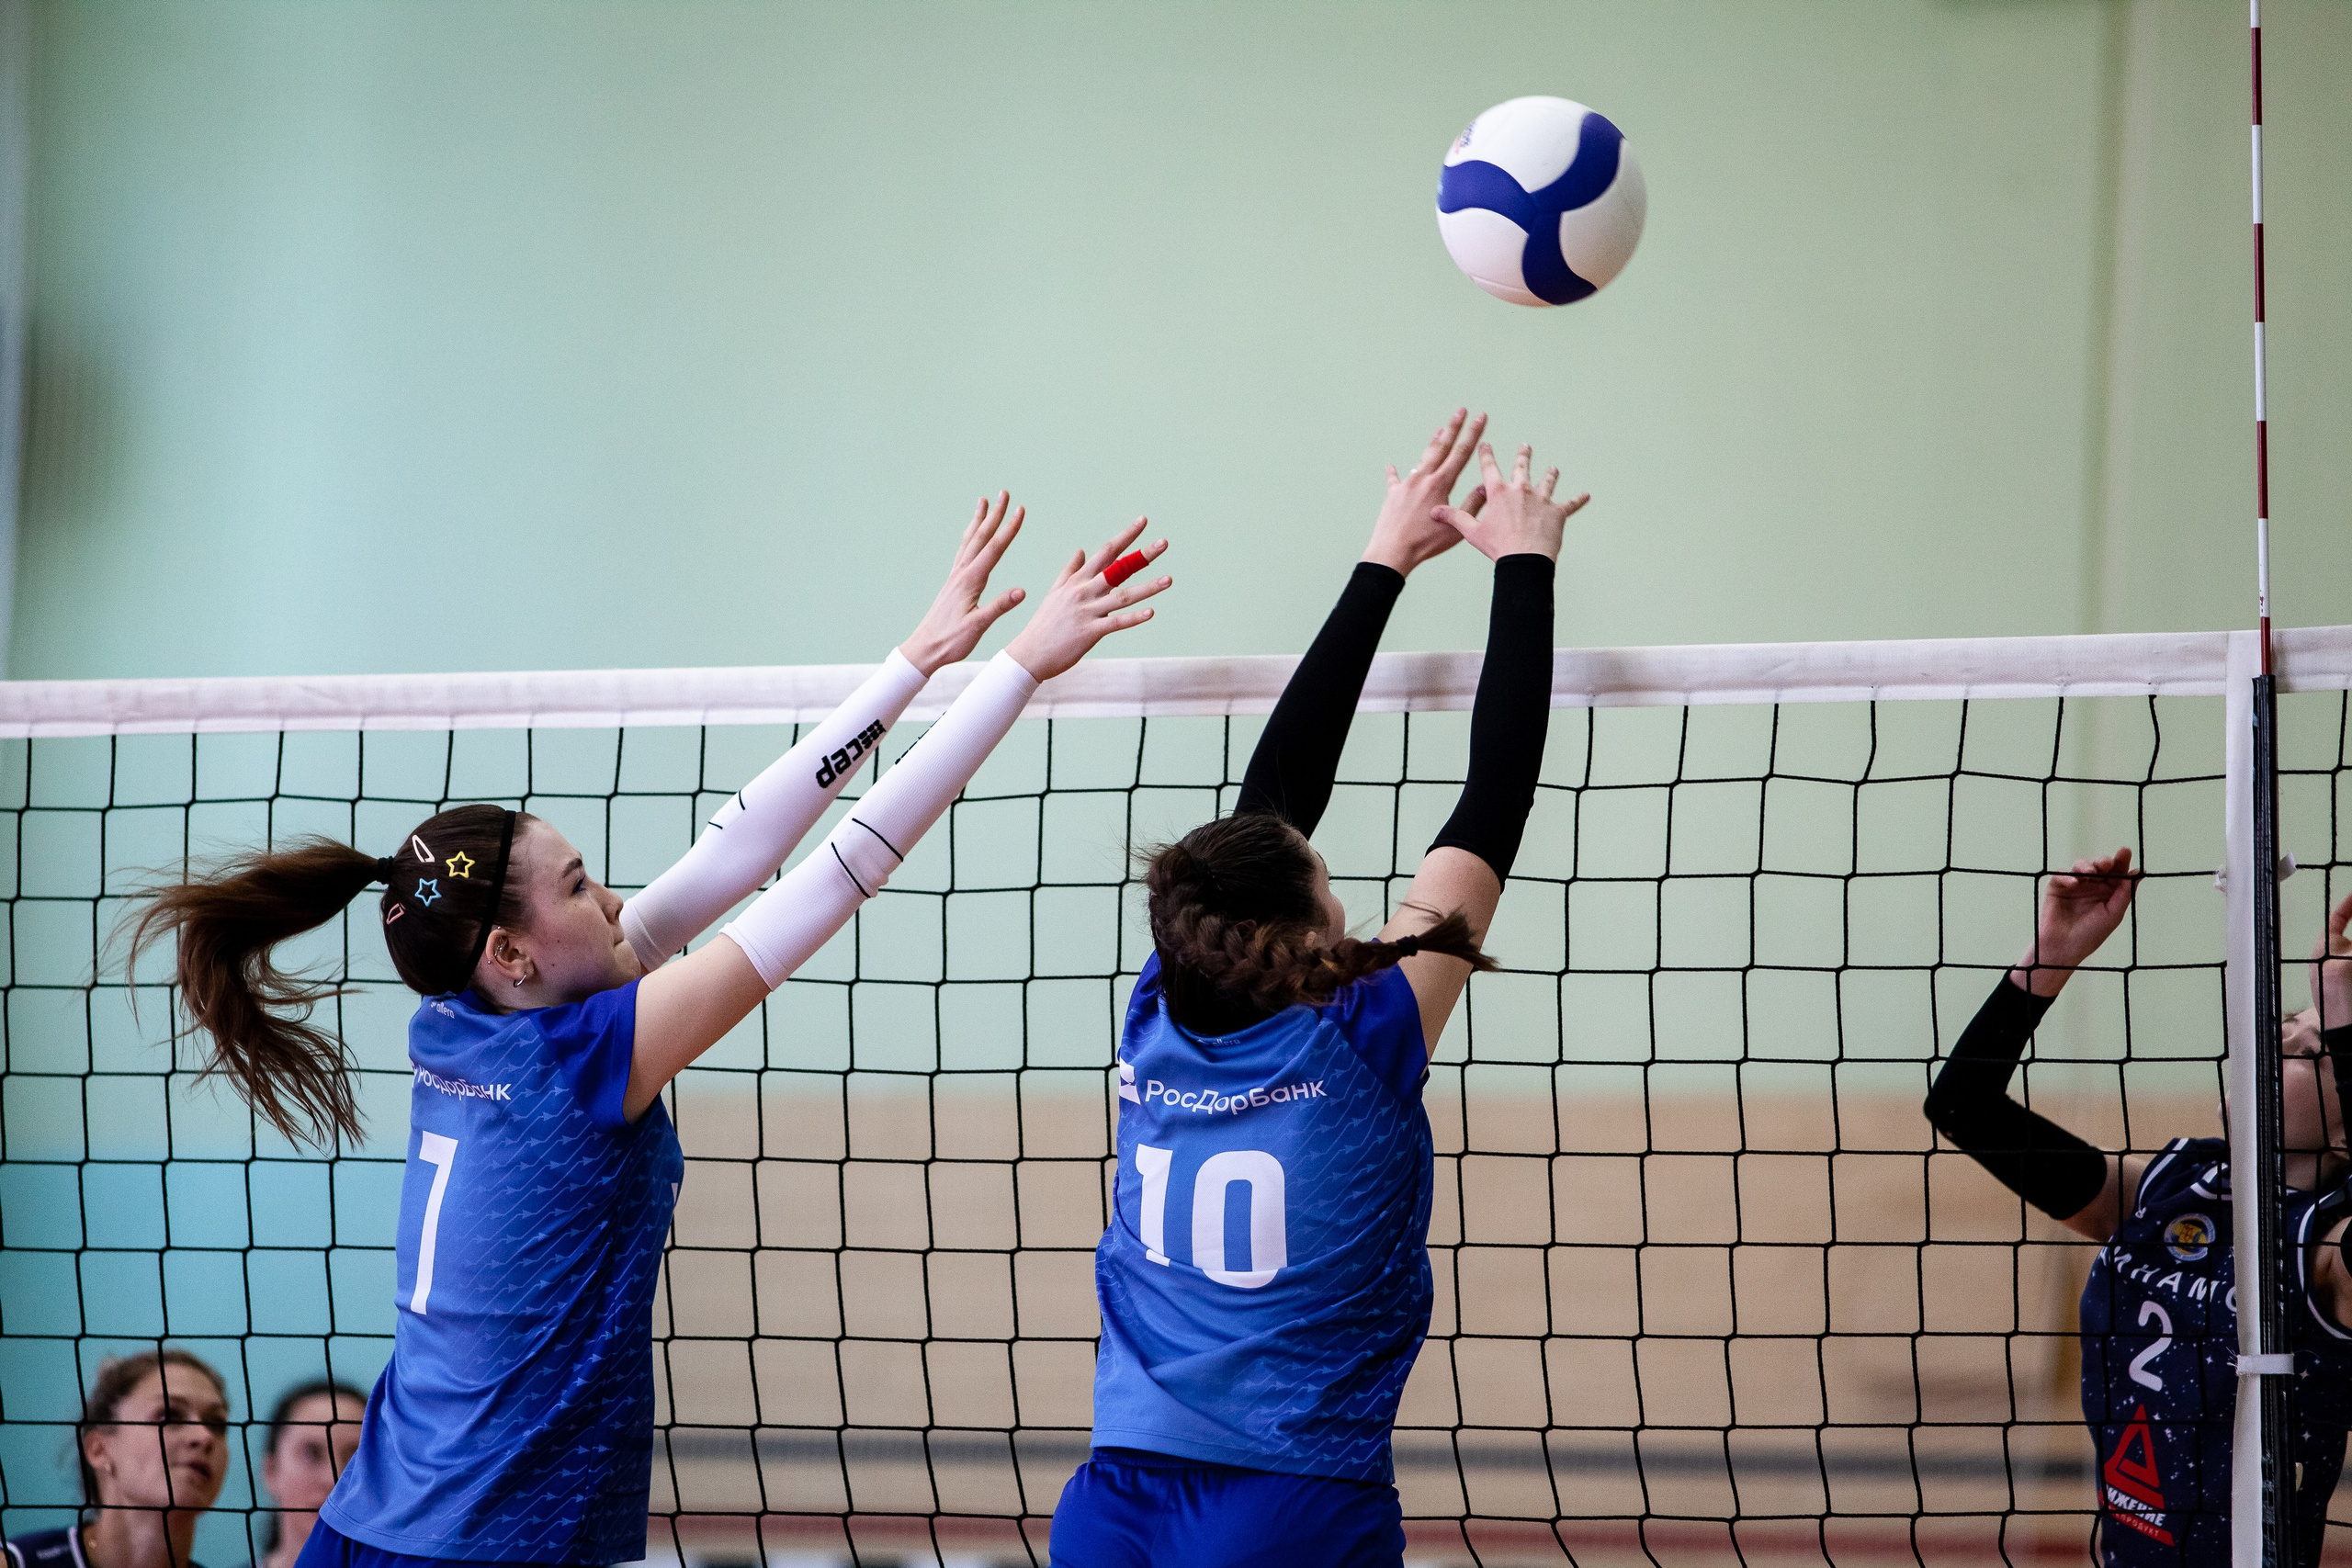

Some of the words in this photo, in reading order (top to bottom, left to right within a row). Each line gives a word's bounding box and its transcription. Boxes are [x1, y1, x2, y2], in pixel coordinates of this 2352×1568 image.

[816, 738, 864, 789] cep
[1145, 1079, 1327, 1114] РосДорБанк
[411, 1130, 458, 1315] 7
[1136, 1143, 1287, 1289] 10
[2129, 1301, 2173, 1392] 2
